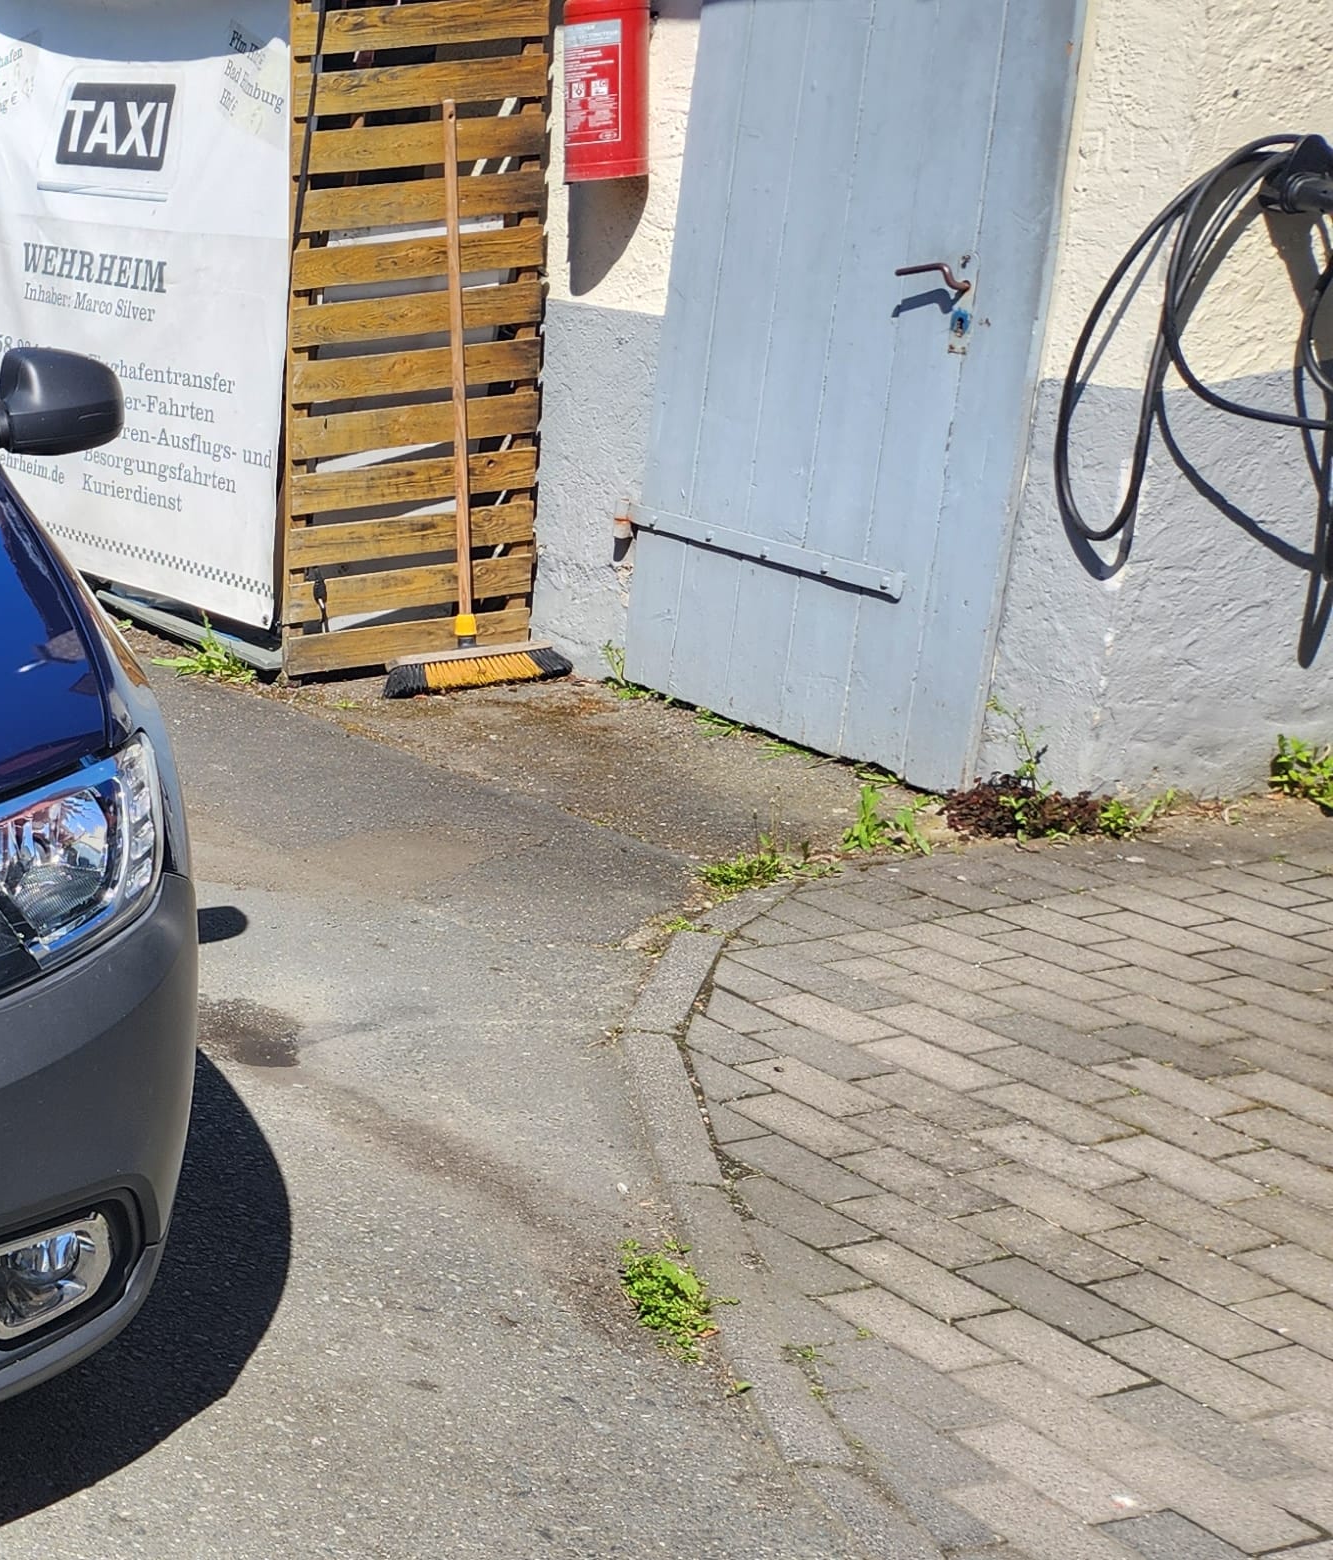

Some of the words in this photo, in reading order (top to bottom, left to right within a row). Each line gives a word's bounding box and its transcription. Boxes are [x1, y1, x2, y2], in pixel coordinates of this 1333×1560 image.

[224, 59, 243, 83] Bad
[66, 100, 168, 158] TAXI
[23, 241, 167, 294] WEHRHEIM
[23, 282, 71, 308] Inhaber:
[73, 291, 113, 316] Marco
[115, 298, 156, 322] Silver
[88, 353, 236, 394] ghafentransfer
[124, 395, 215, 424] er-Fahrten
[0, 451, 65, 485] ehrheim.de
[119, 426, 237, 463] ren-Ausflugs-
[243, 448, 272, 470] und
[83, 449, 237, 493] Besorgungsfahrten
[82, 473, 183, 512] Kurierdienst
